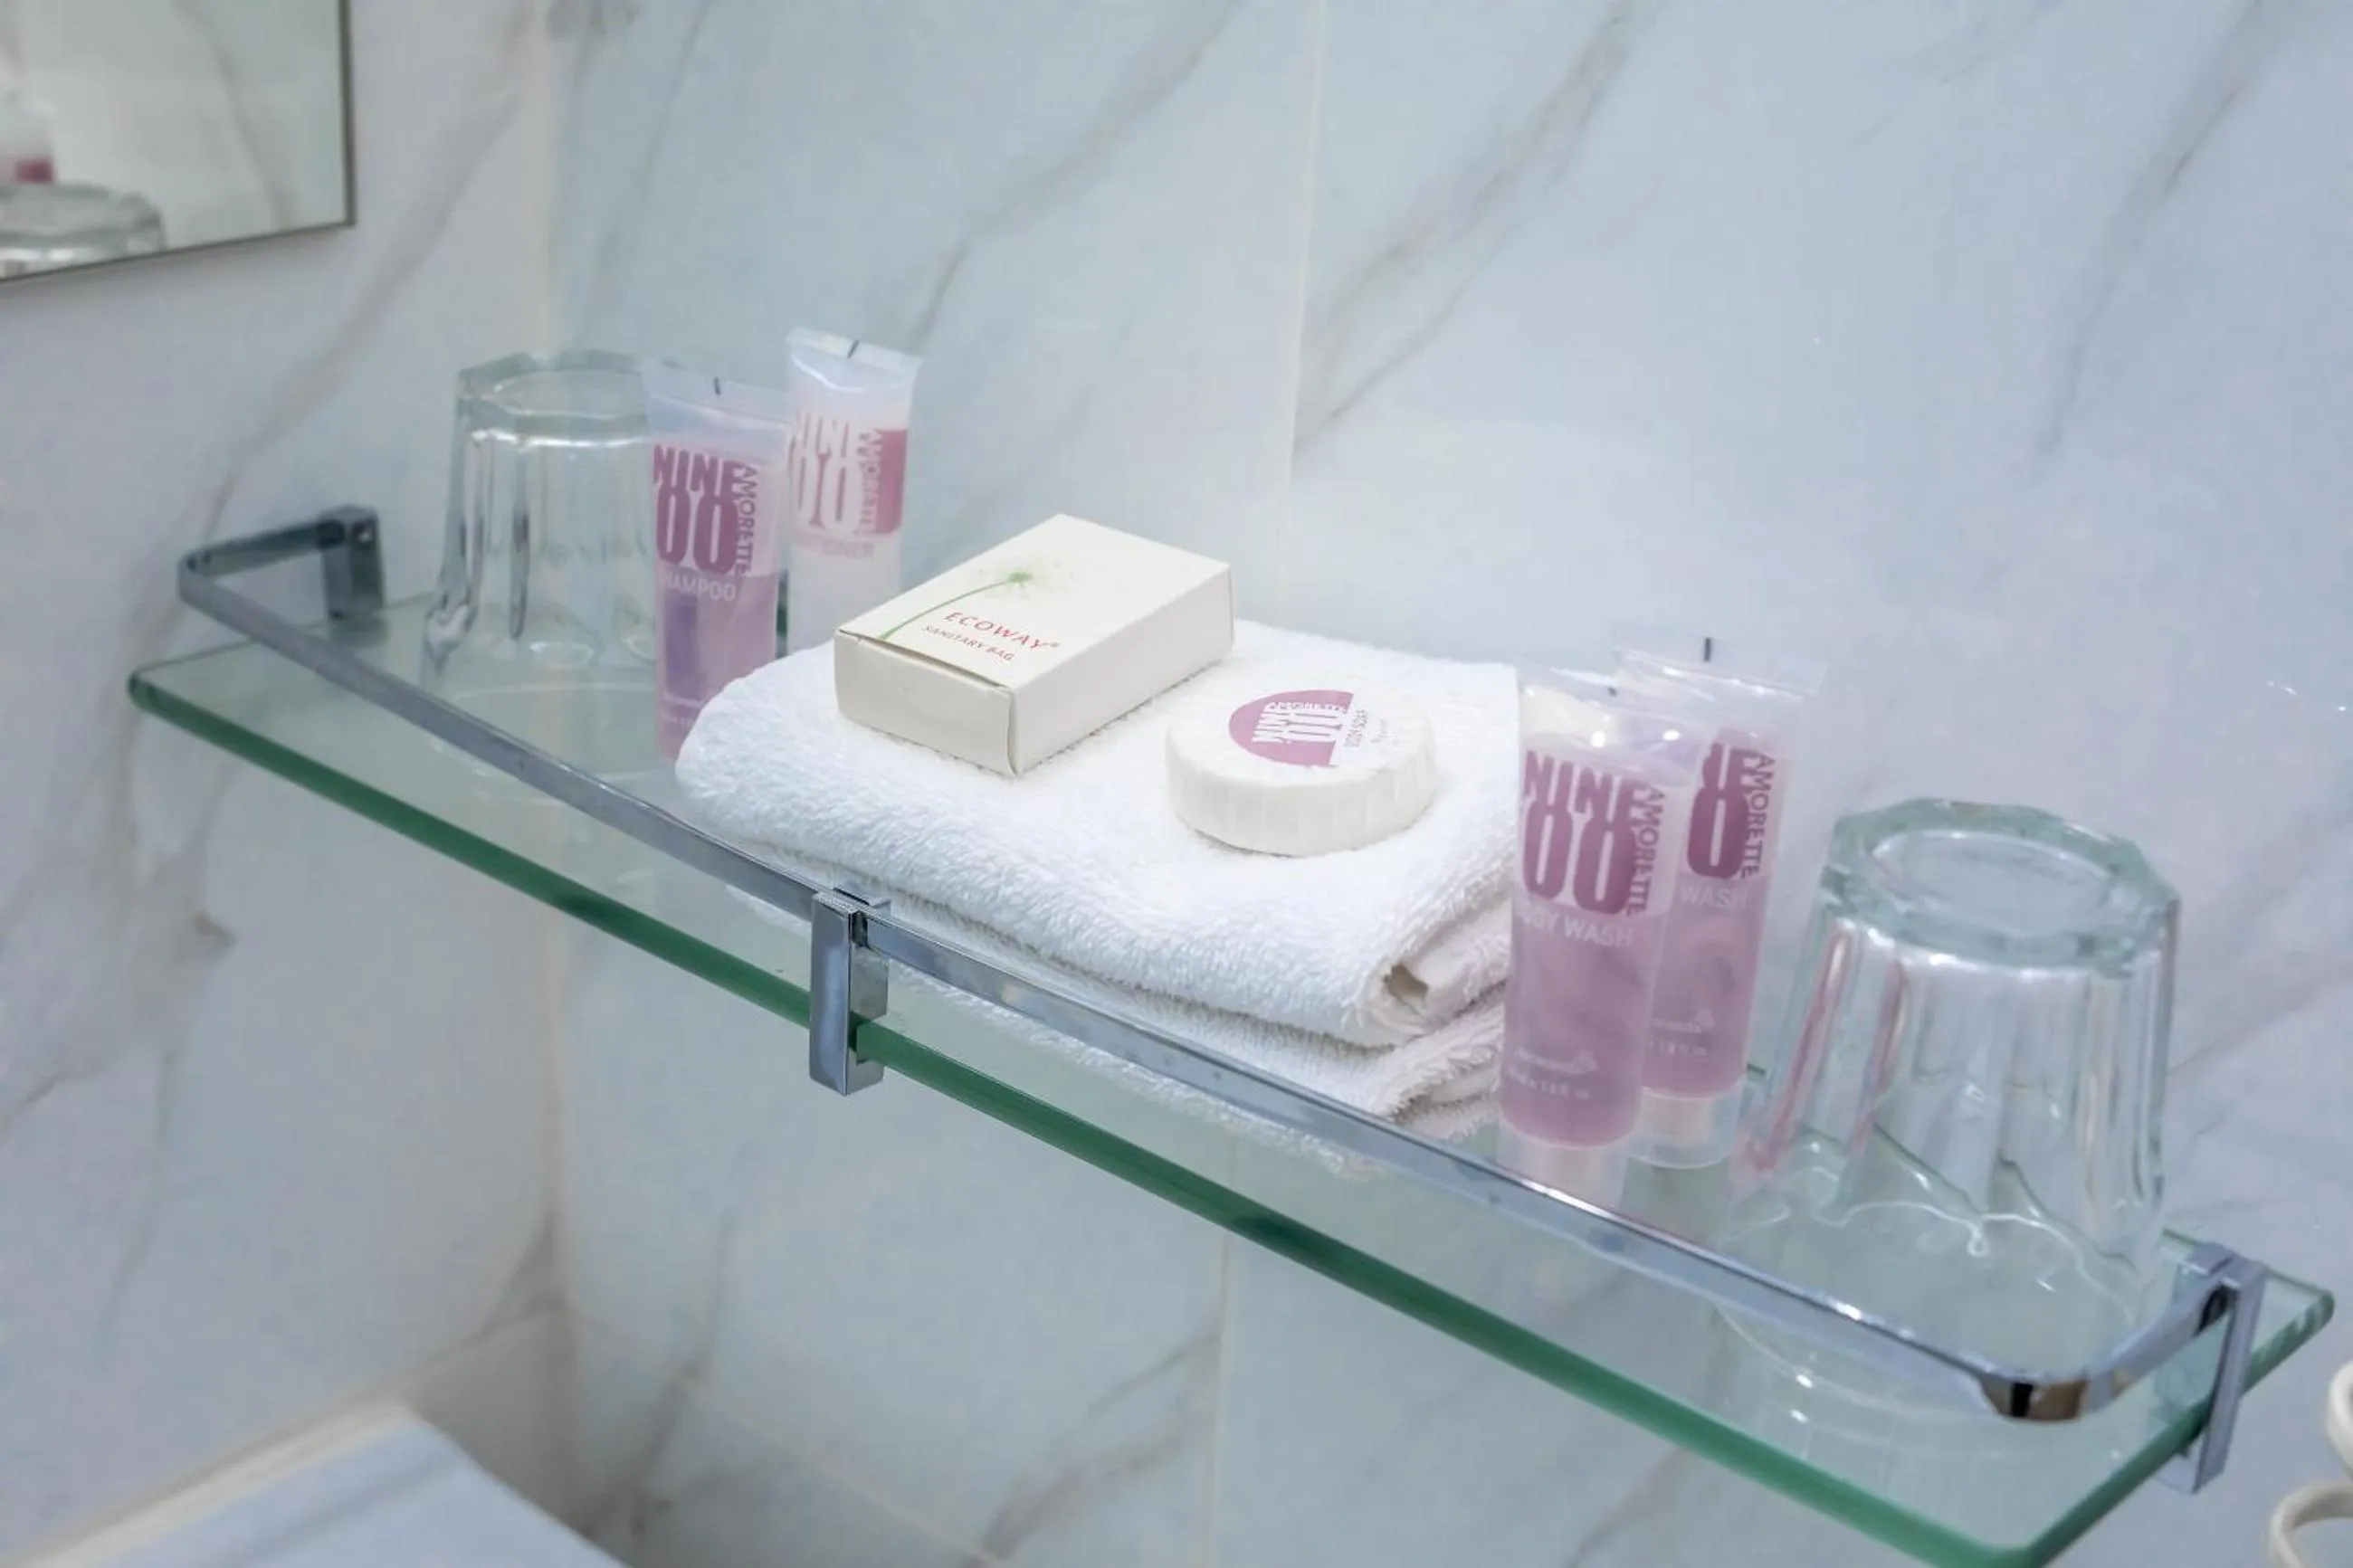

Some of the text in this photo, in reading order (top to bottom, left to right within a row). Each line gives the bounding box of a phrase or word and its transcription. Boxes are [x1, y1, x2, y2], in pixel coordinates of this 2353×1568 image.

[734, 463, 759, 577] AMORETTE
[922, 624, 1016, 661] SANITARY BAG
[1626, 785, 1667, 917] AMORETTE
[1739, 750, 1776, 880] AMORETTE
[1564, 915, 1634, 948] WASH
